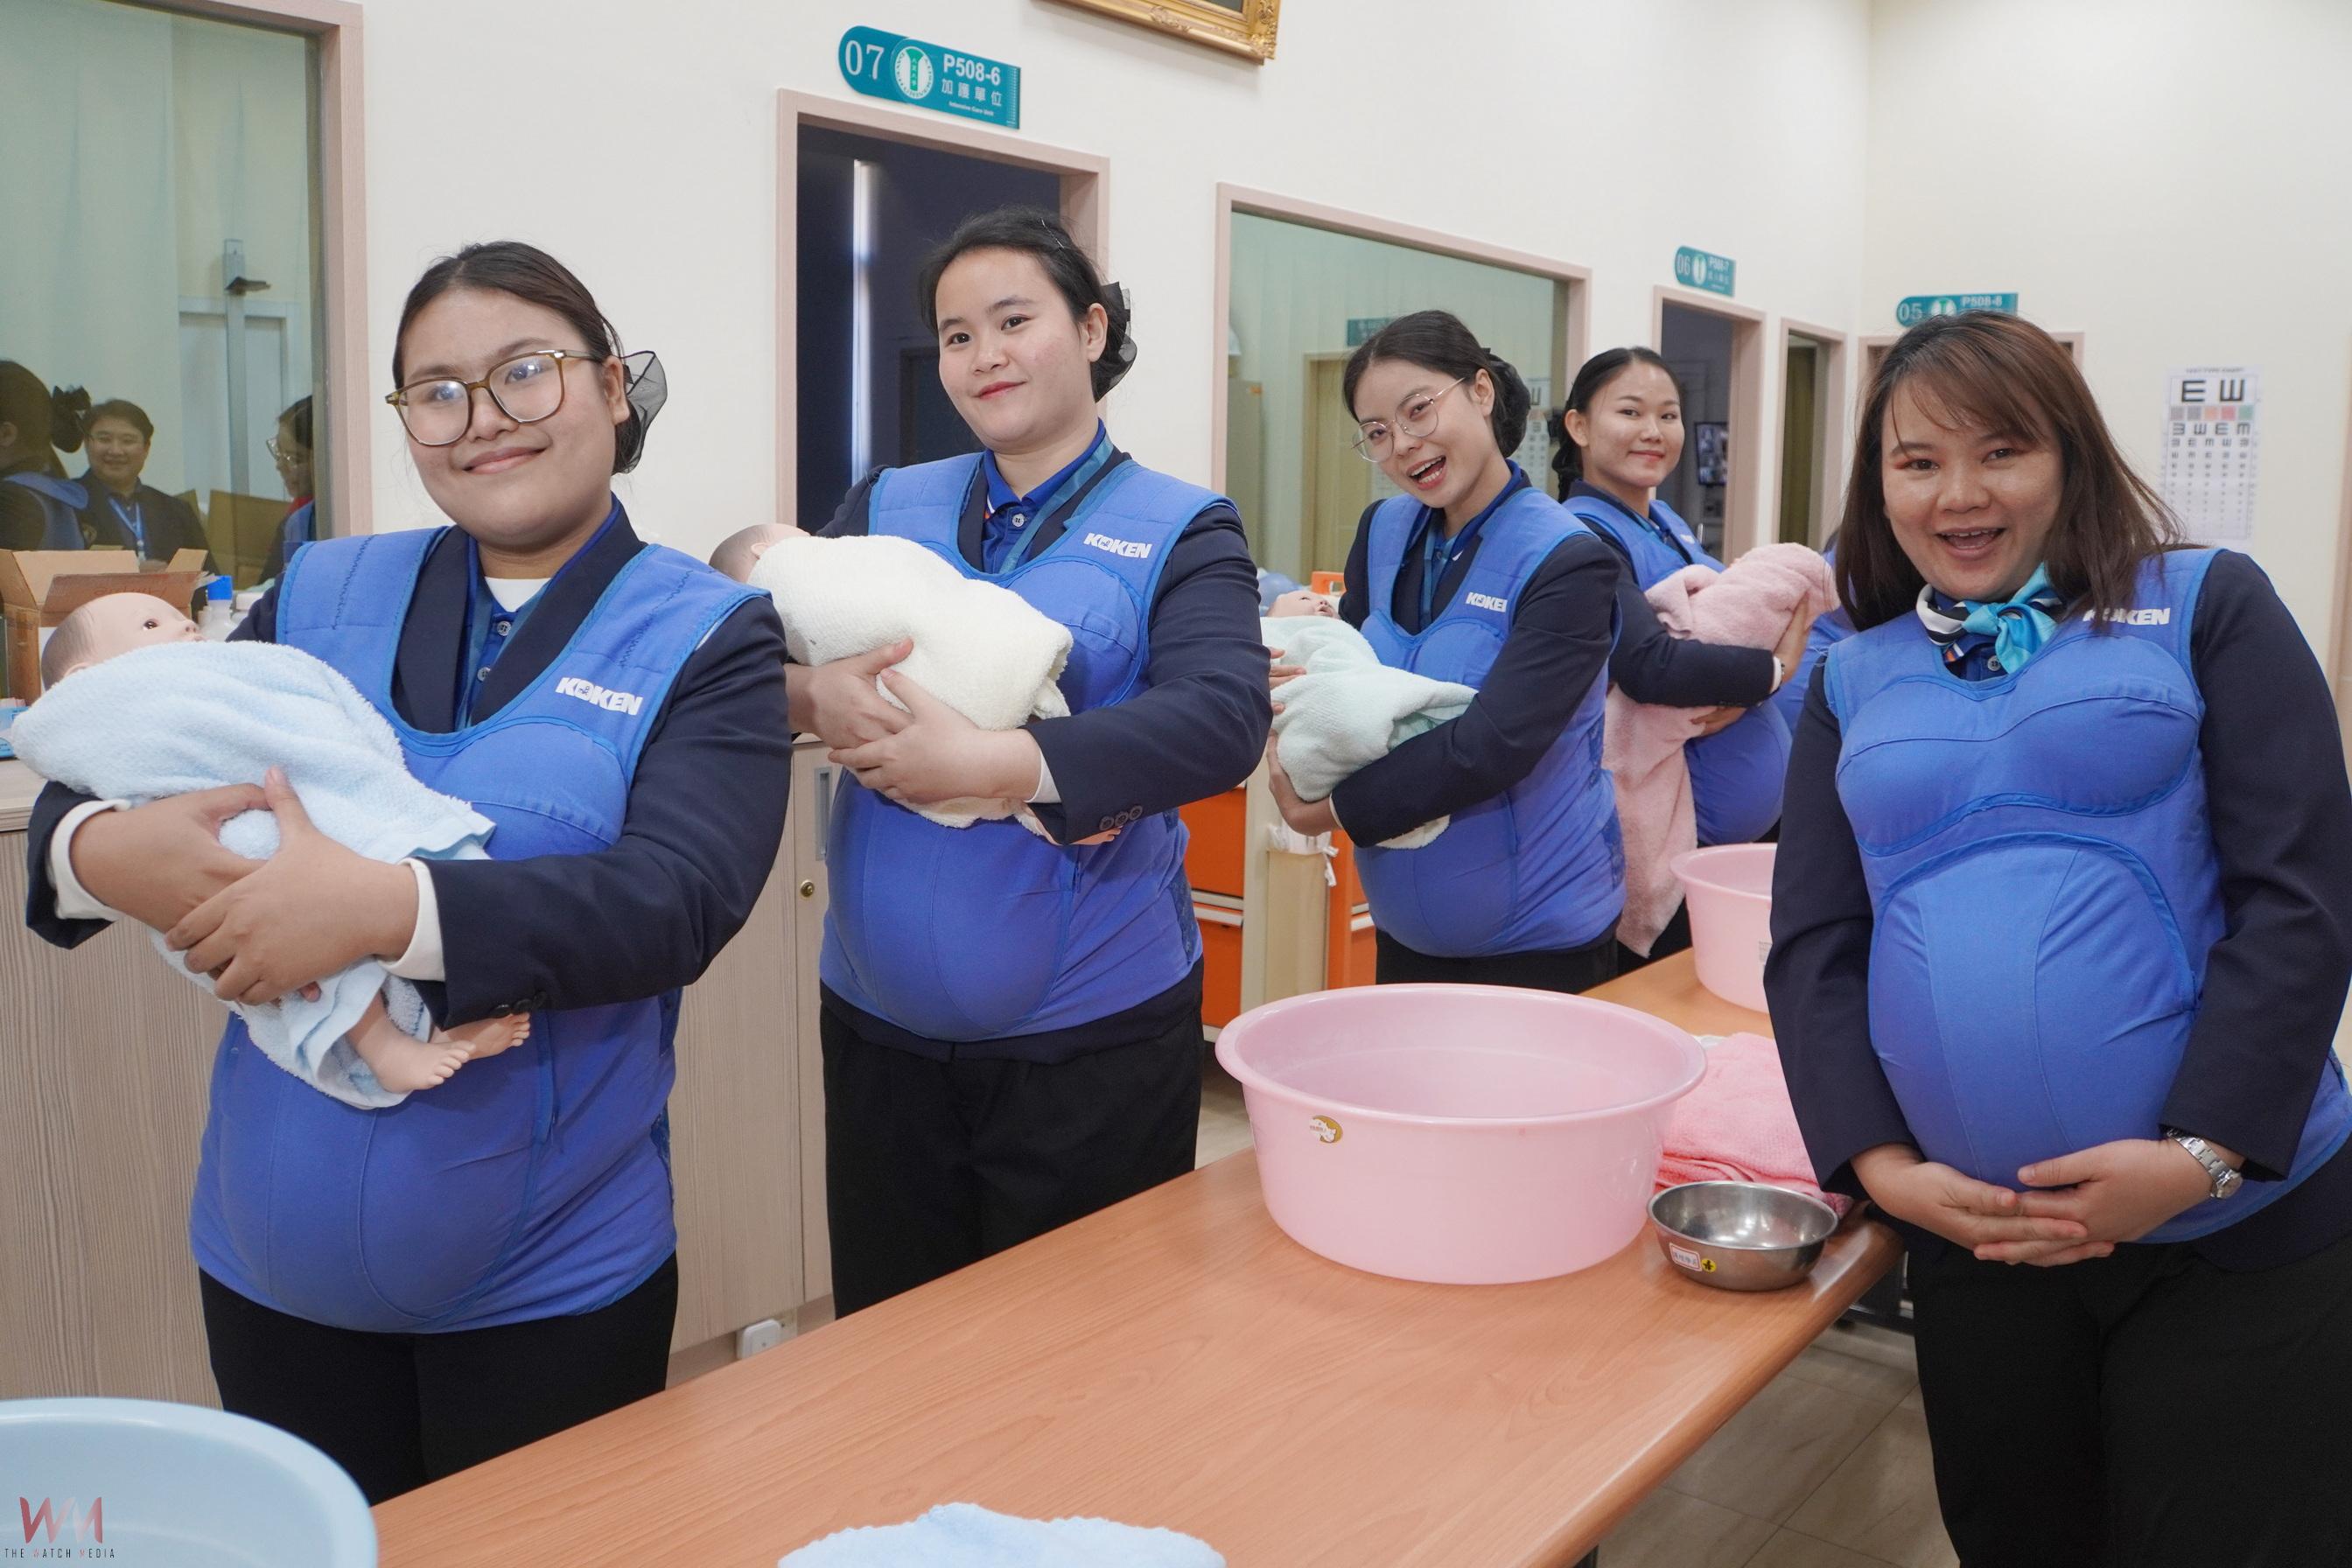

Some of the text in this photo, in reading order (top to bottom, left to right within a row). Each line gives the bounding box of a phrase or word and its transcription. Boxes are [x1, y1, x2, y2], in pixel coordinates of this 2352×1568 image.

[845, 39, 885, 80] 07
[943, 53, 1001, 86] P508-6
[1899, 303, 1923, 321] 05
[1083, 532, 1152, 559] KOKEN
[1466, 592, 1508, 612] KOKE
[556, 677, 643, 716] KOKEN
